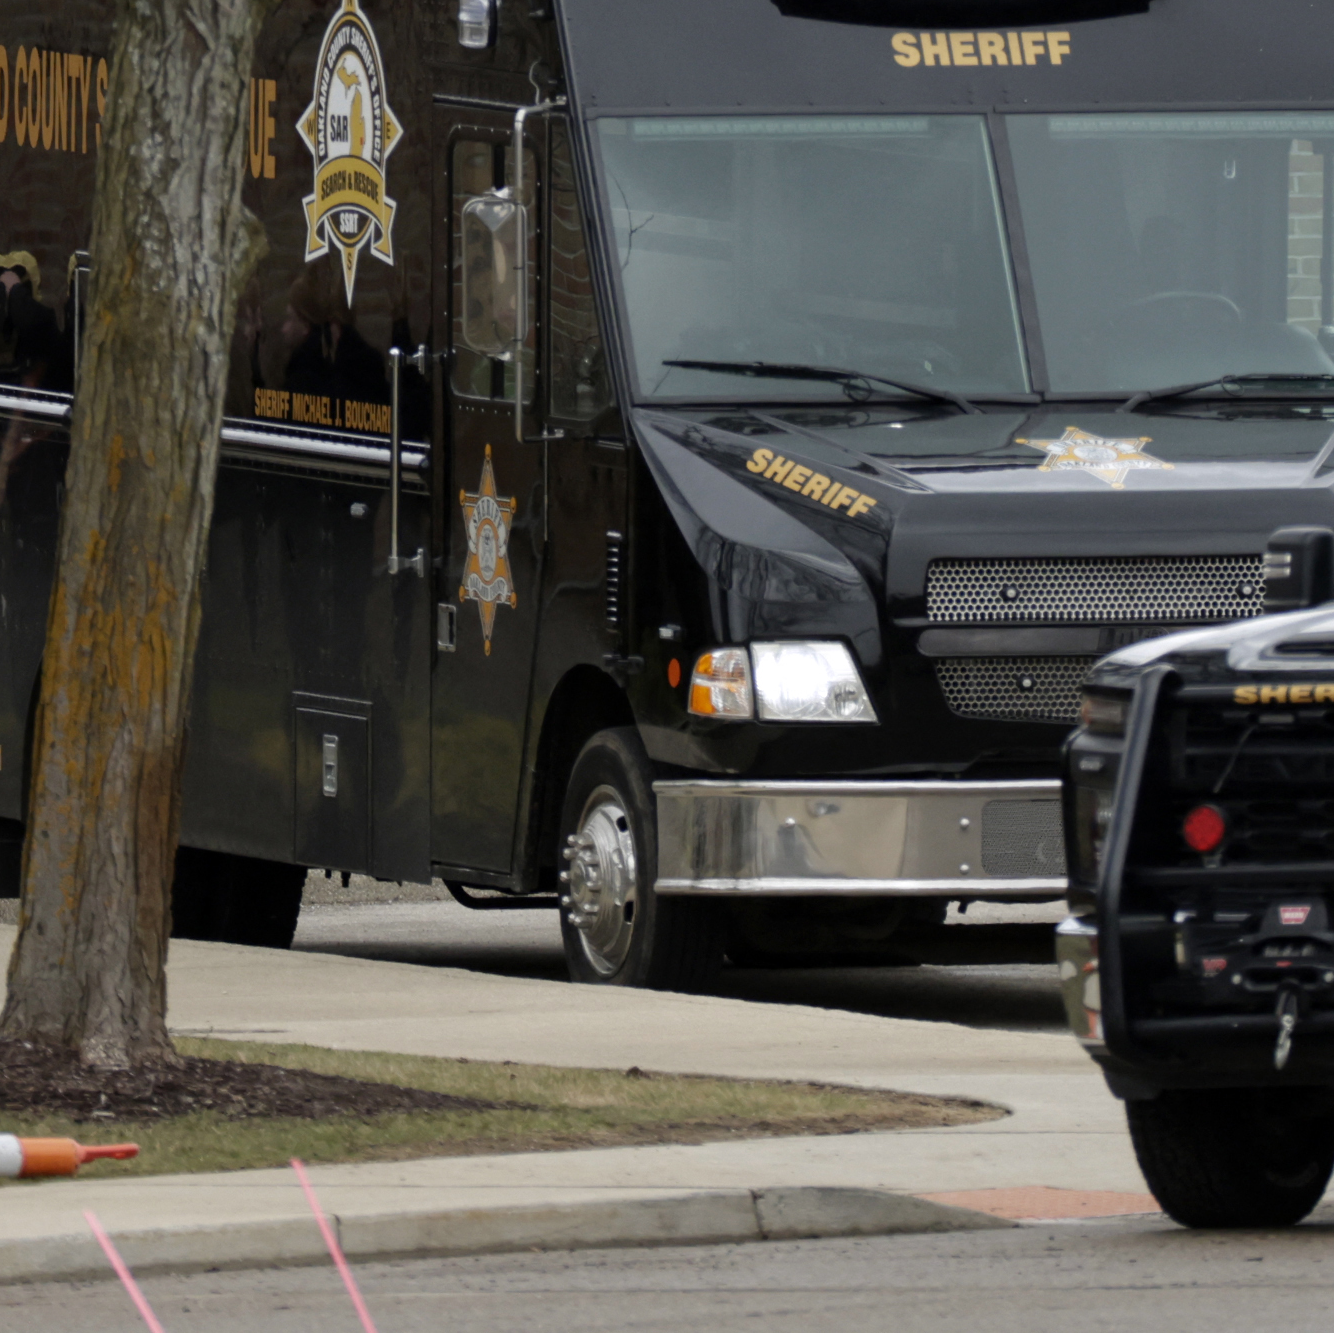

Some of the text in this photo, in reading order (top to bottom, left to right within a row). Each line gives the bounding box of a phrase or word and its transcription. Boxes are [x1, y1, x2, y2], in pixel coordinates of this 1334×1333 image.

[891, 31, 1071, 67] SHERIFF
[14, 45, 92, 154] COUNTY
[318, 67, 330, 157] OAKLAND
[327, 26, 351, 68] COUNTY
[372, 93, 382, 163] OFFICE
[330, 114, 348, 143] SAR
[321, 170, 379, 205] SEARCH & RESCUE
[339, 212, 359, 234] SSRT
[255, 387, 290, 419] SHERIFF
[292, 392, 332, 425] MICHAEL
[746, 448, 877, 517] SHERIFF
